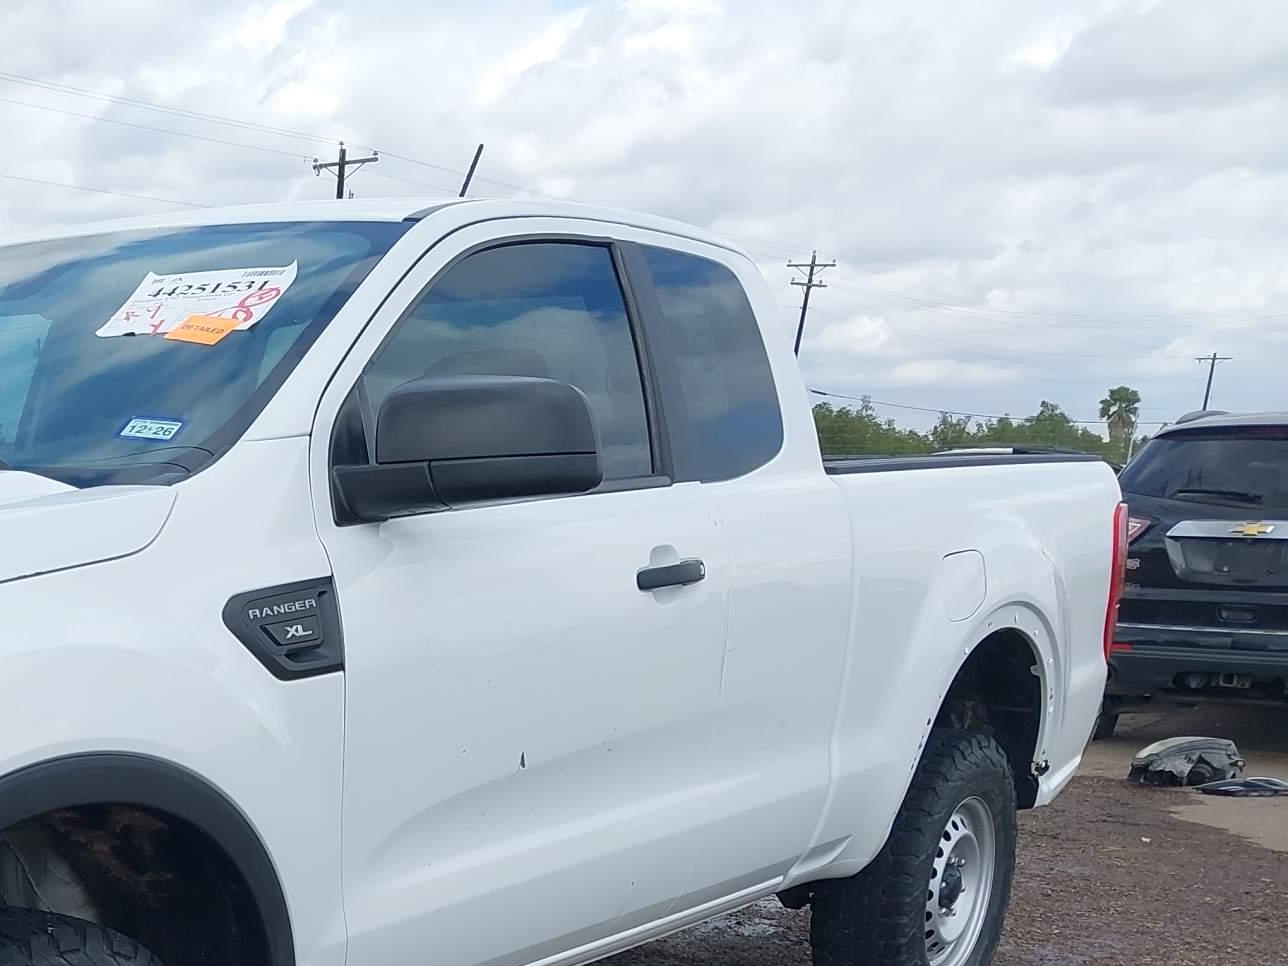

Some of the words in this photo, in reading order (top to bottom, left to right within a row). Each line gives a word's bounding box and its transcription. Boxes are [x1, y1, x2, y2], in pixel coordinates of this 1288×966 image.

[148, 280, 270, 298] 44251531
[181, 323, 225, 335] DETAILED
[248, 599, 317, 619] RANGER
[284, 625, 313, 640] XL
